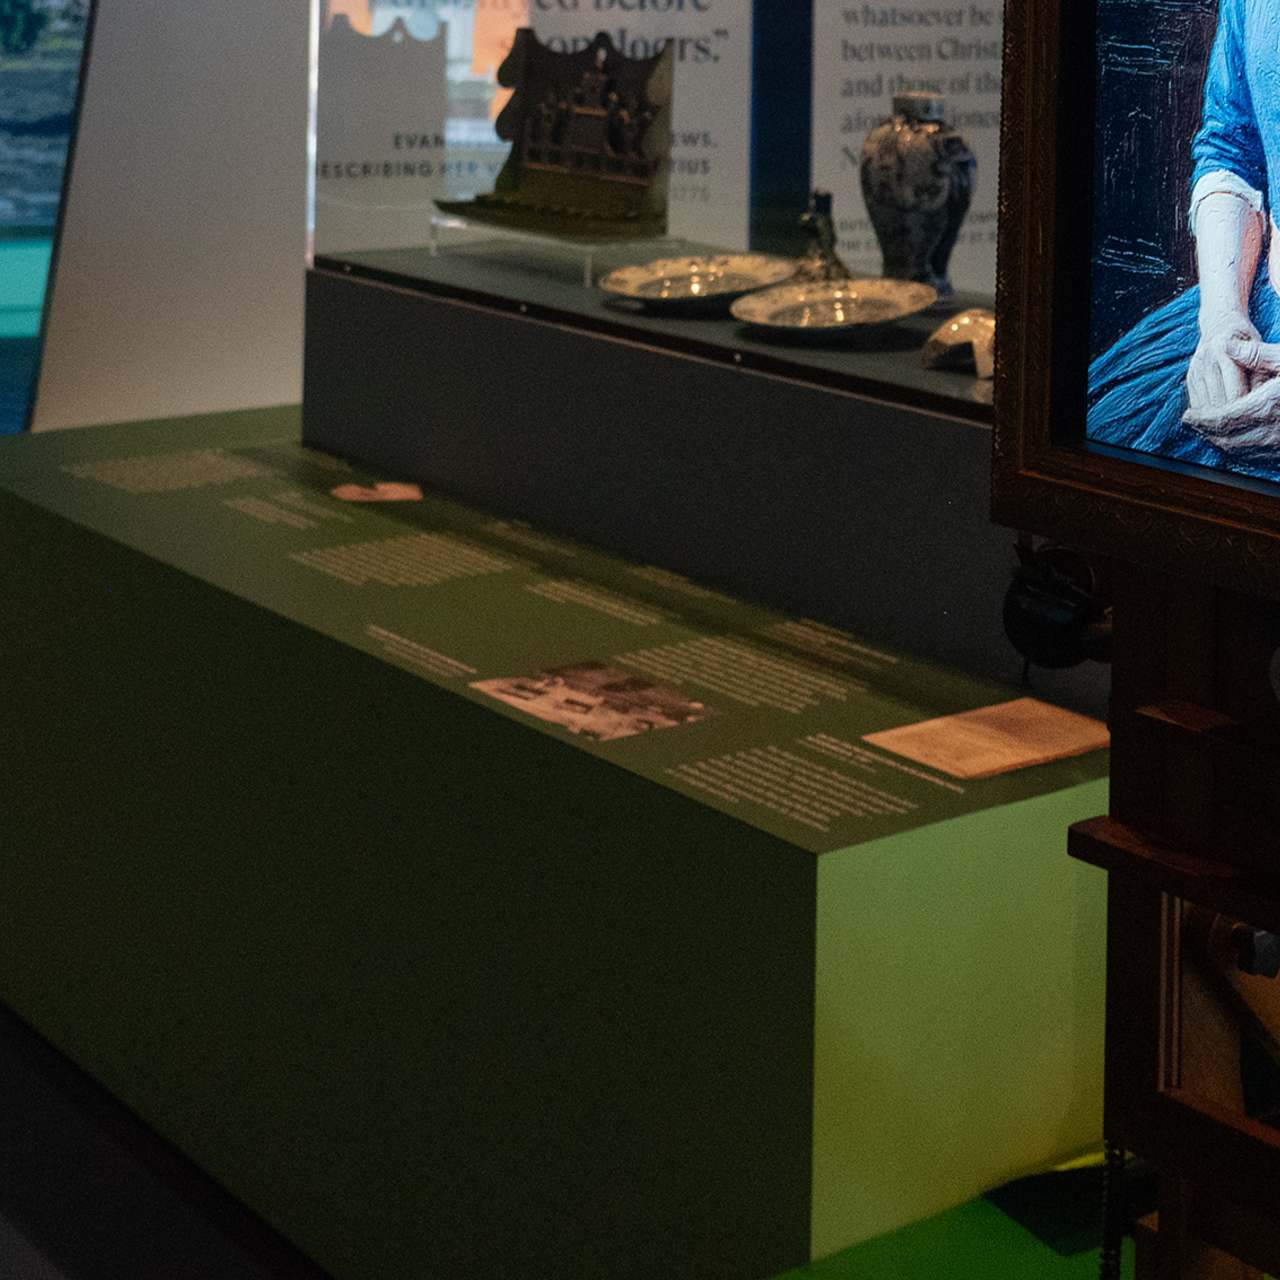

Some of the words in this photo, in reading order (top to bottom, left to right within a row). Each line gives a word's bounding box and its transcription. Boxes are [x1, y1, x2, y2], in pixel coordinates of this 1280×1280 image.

[842, 4, 963, 26] whatsoever
[969, 5, 993, 26] be
[841, 38, 932, 61] between
[936, 36, 1000, 61] Christ
[842, 74, 883, 98] and
